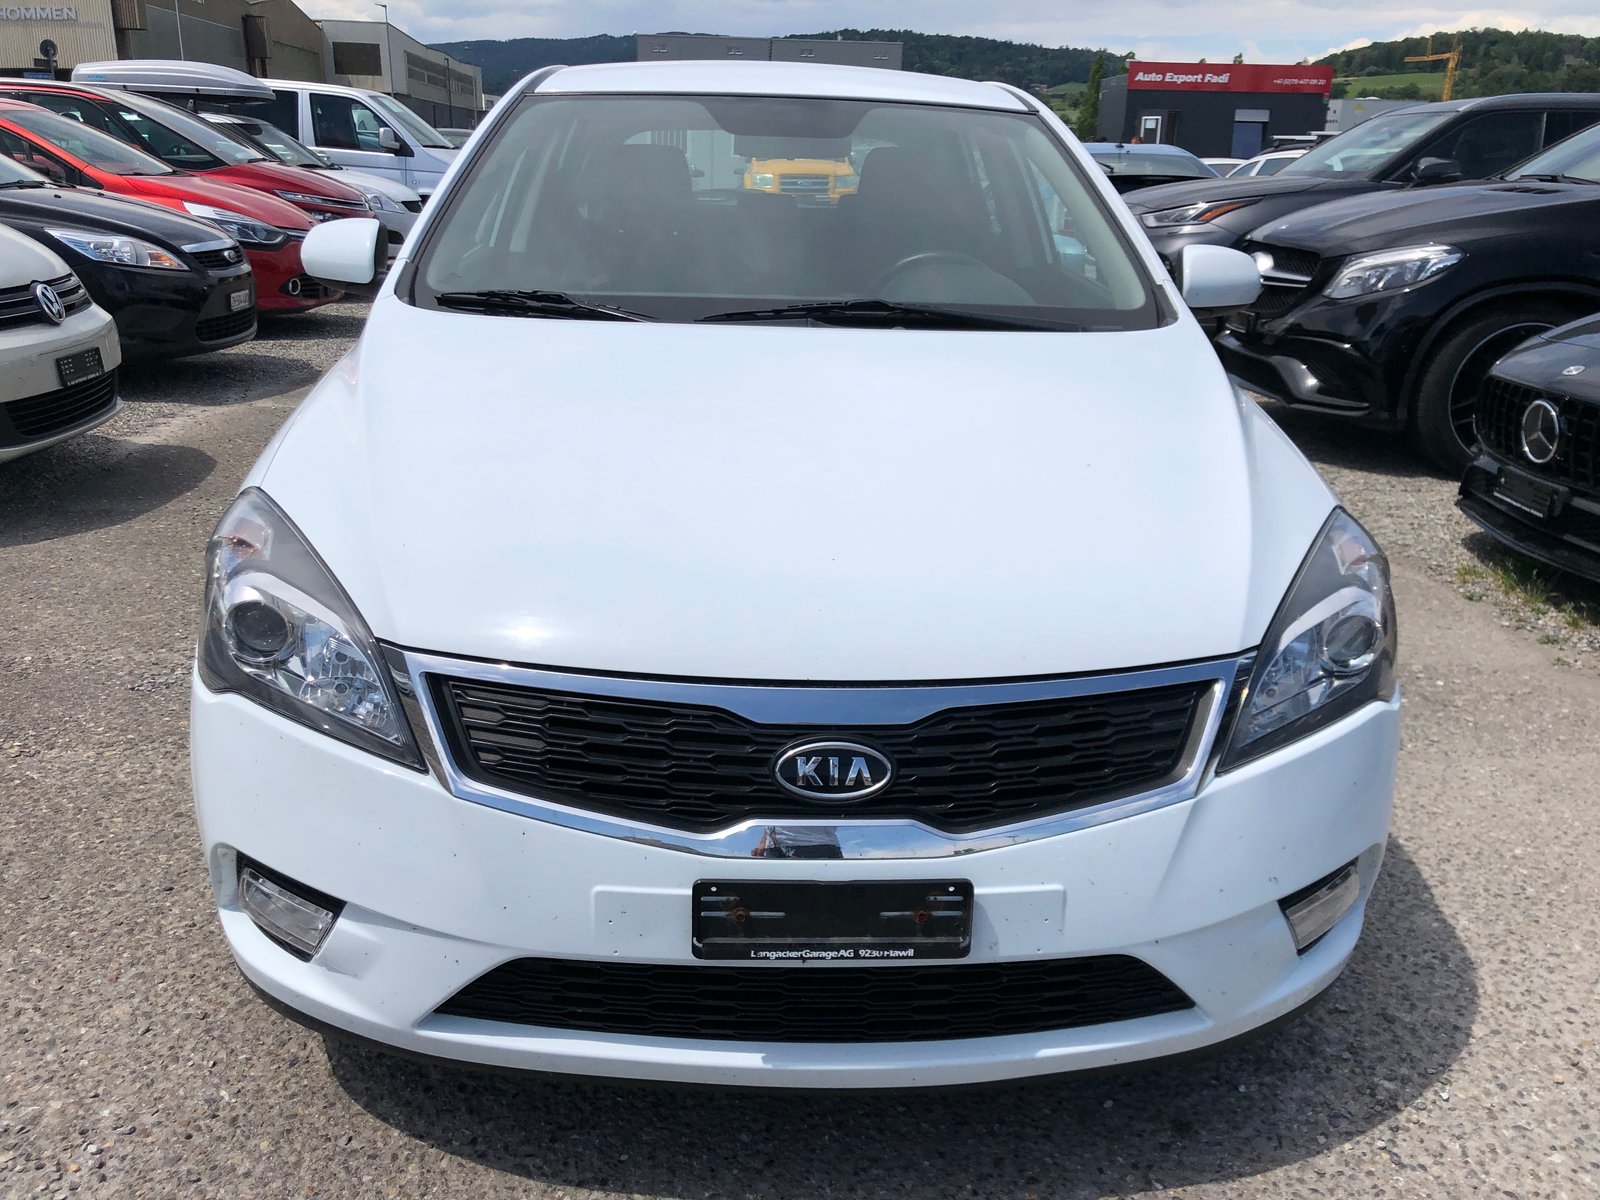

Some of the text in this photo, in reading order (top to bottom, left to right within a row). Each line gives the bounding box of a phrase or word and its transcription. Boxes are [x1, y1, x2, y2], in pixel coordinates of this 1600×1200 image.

[1135, 72, 1230, 84] Auto Export Fadi
[796, 756, 873, 786] KIA
